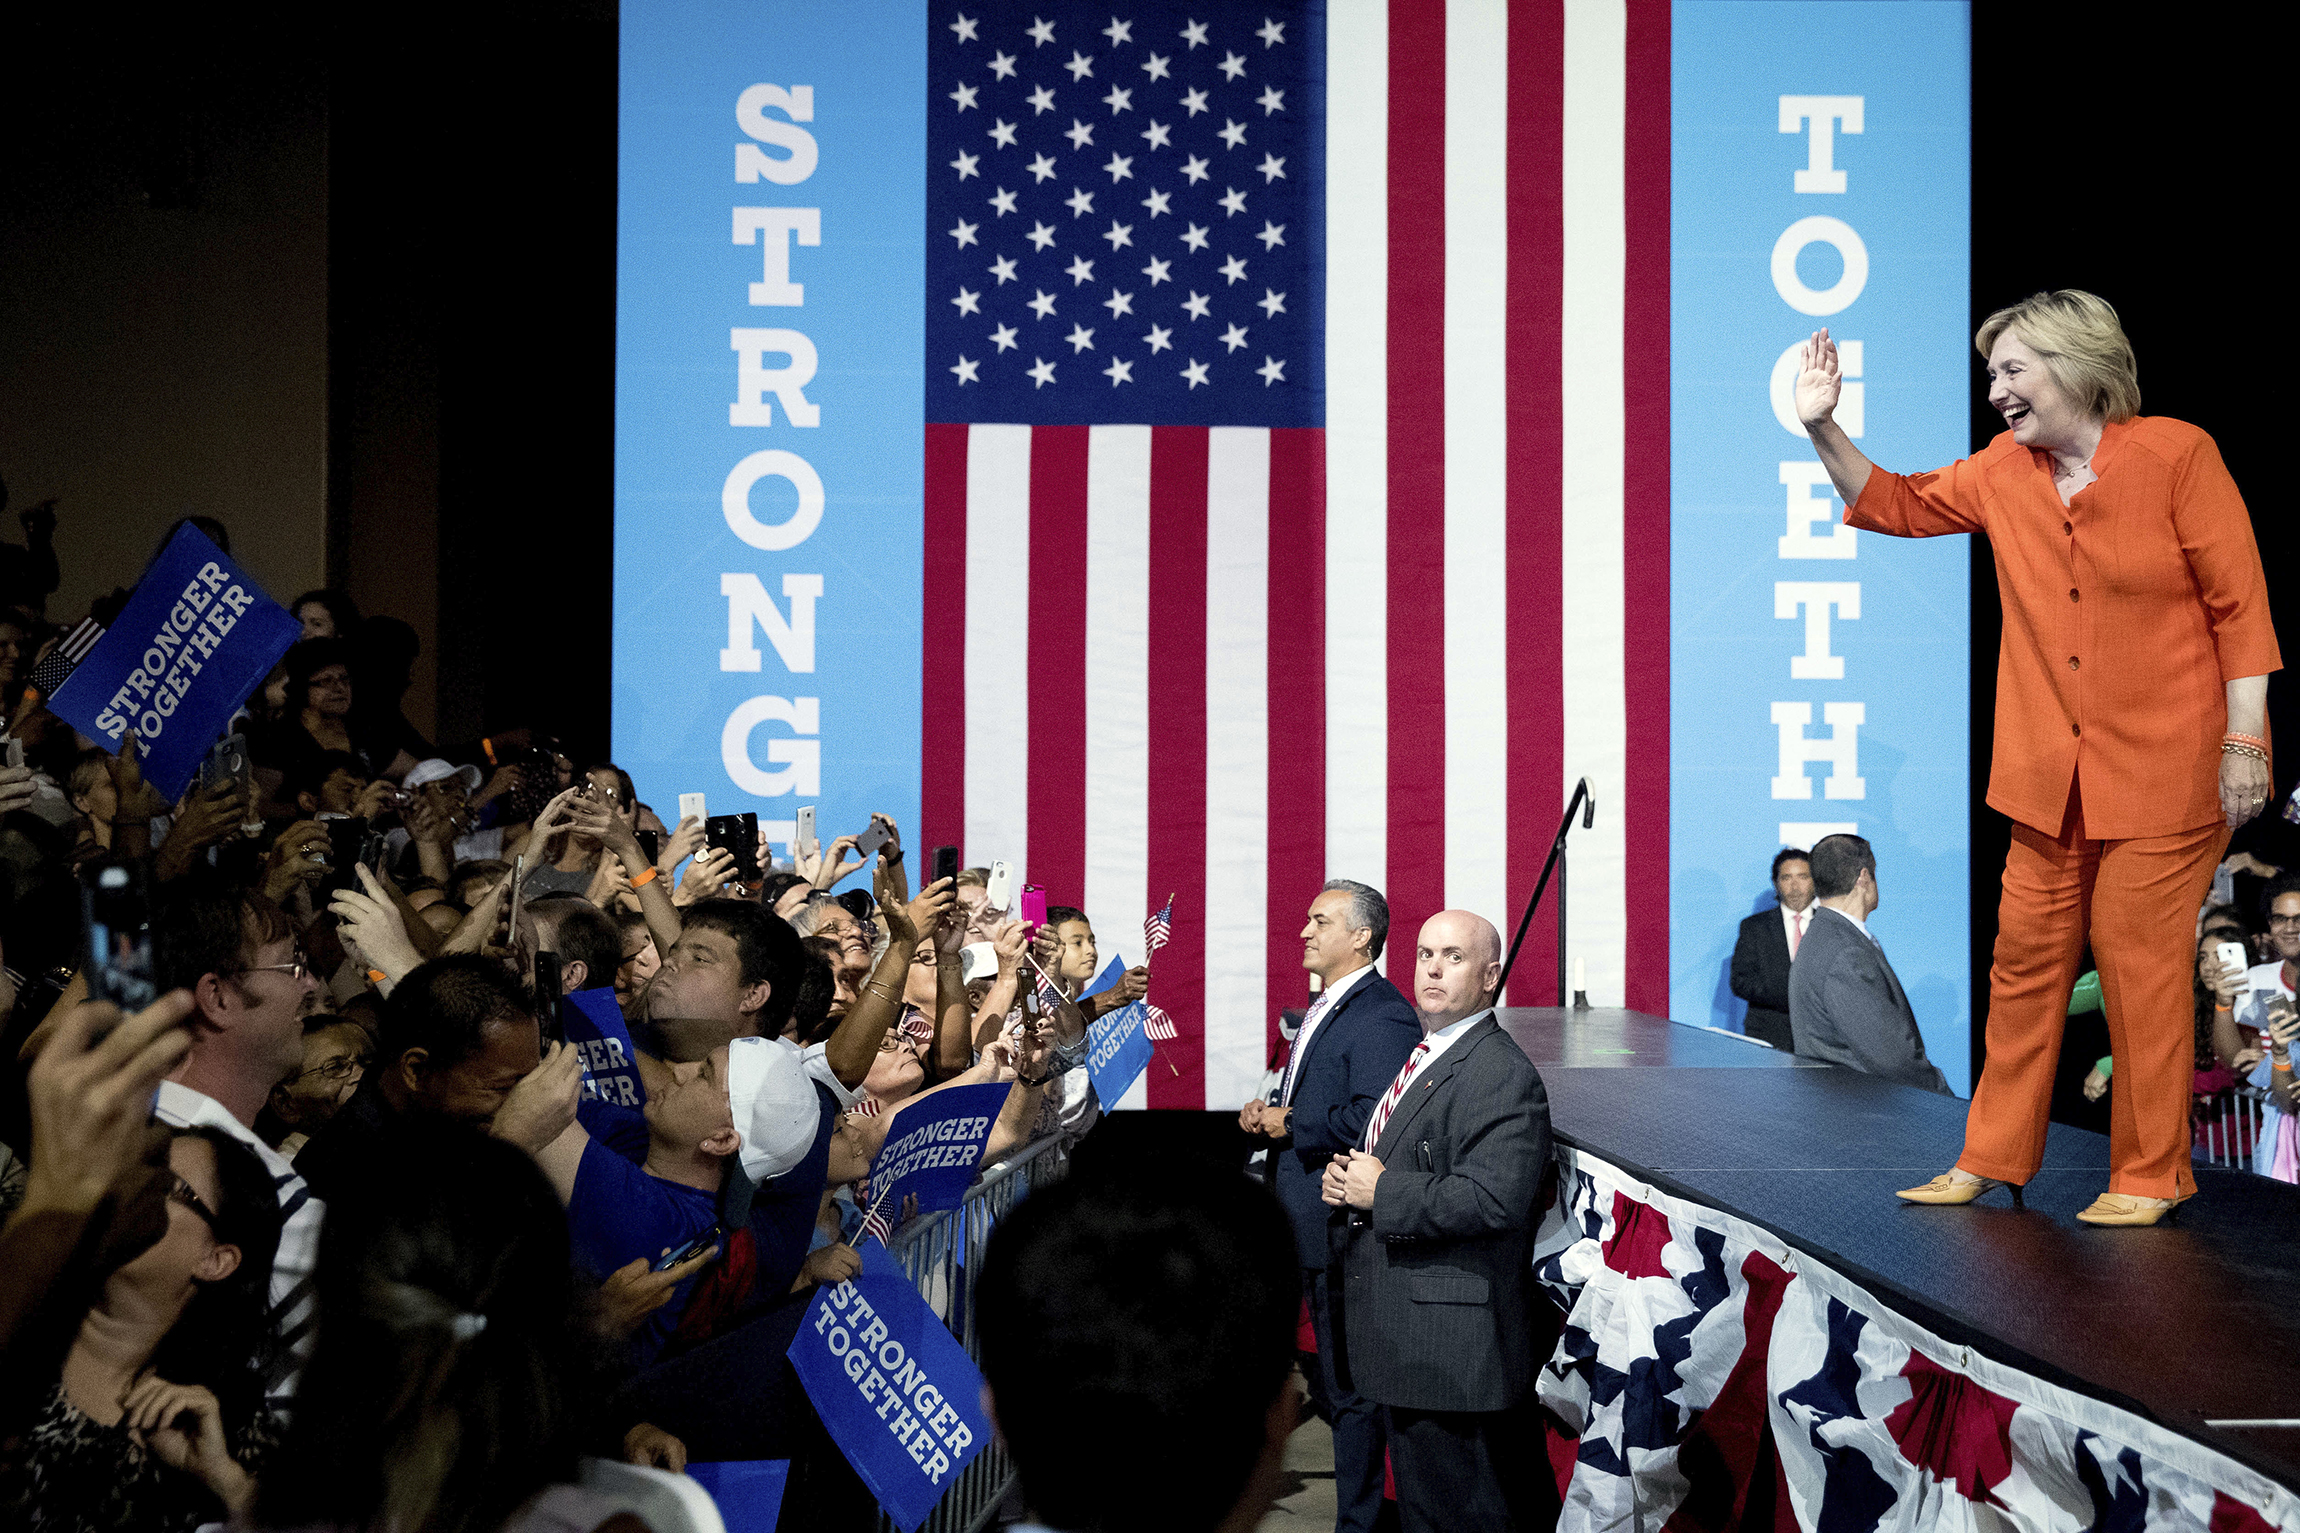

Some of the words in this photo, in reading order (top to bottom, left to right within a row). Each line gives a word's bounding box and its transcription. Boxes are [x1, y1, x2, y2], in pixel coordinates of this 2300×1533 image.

[719, 82, 826, 866] STRONG
[1769, 94, 1869, 853] TOGETH
[95, 561, 231, 740] STRONGER
[1088, 1004, 1142, 1076] TOGETHER
[871, 1144, 979, 1201] TOGETHER
[876, 1116, 989, 1172] STRONGER
[814, 1301, 950, 1485] TOGETHER
[828, 1278, 973, 1459] STRONGER
